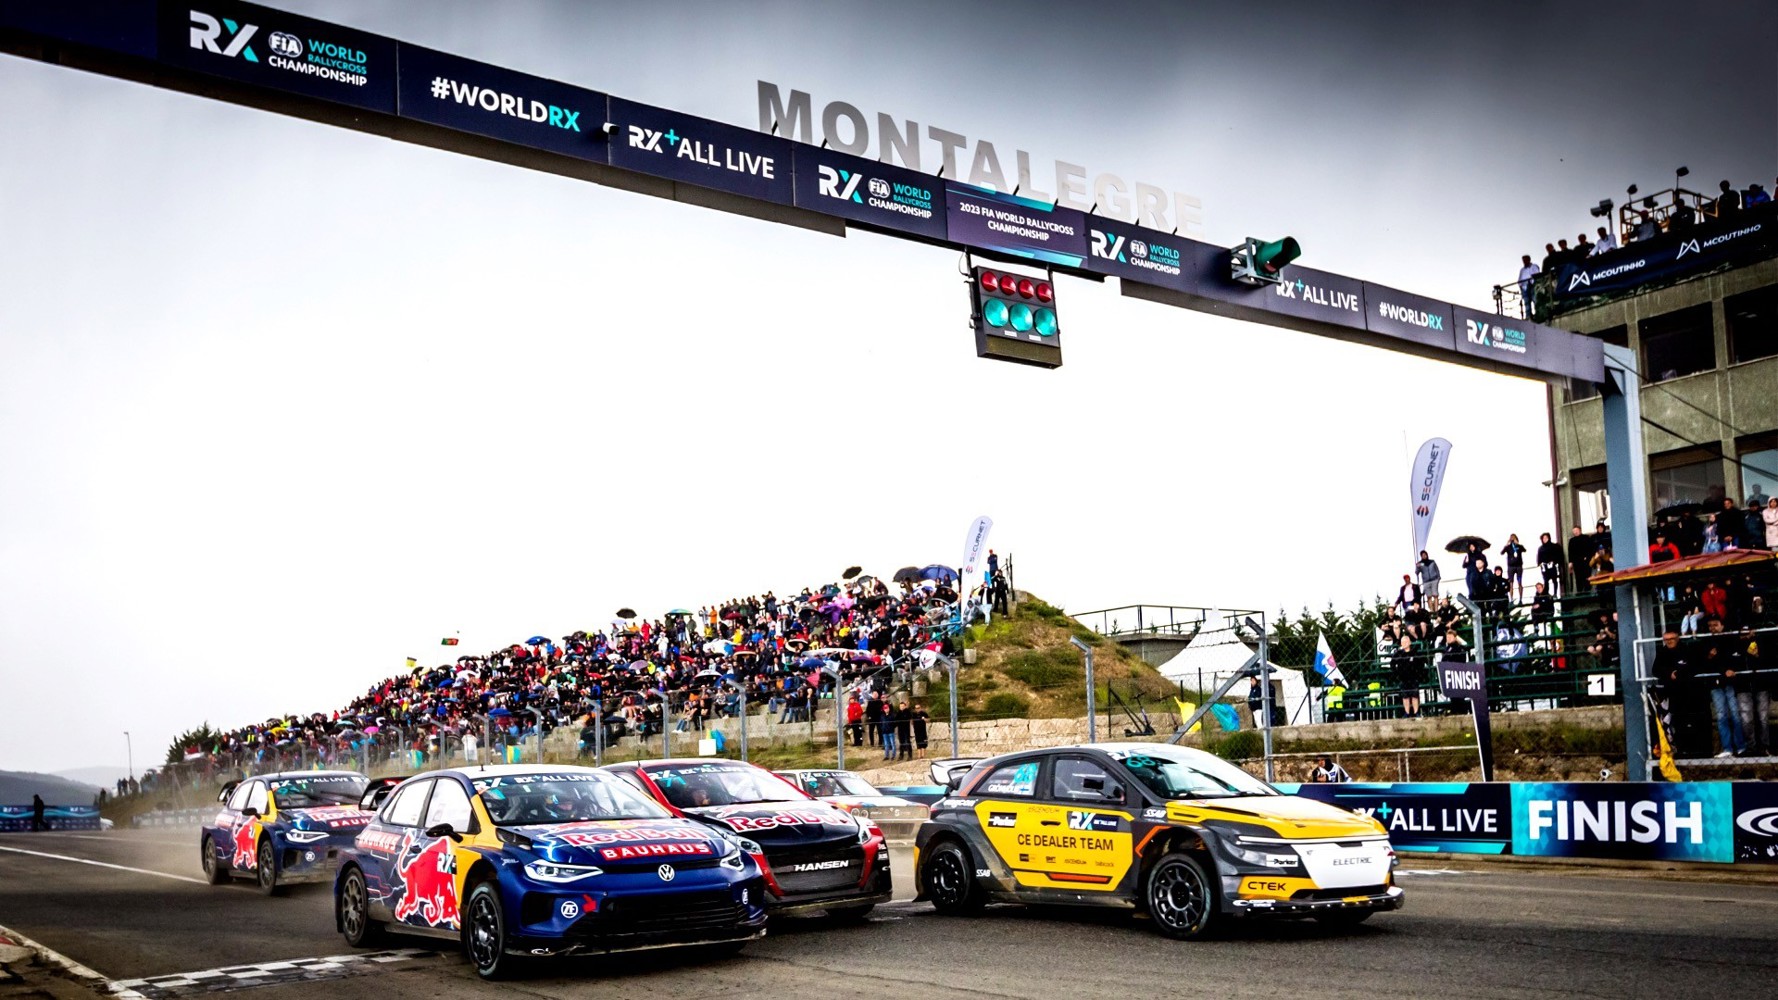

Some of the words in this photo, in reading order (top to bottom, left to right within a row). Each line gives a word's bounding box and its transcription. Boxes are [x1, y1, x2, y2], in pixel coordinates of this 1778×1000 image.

[189, 9, 259, 63] RX
[271, 35, 300, 54] FIA
[308, 38, 367, 64] WORLD
[268, 55, 367, 87] CHAMPIONSHIP
[307, 53, 367, 75] RALLYCROSS
[430, 76, 581, 132] #WORLDRX
[726, 148, 775, 180] LIVE
[757, 79, 1206, 239] MONTALEGRE
[818, 164, 863, 204] RX
[869, 180, 888, 195] FIA
[893, 182, 931, 201] WORLD
[868, 197, 932, 219] CHAMPIONSHIP
[893, 193, 932, 210] RALLYCROSS
[959, 202, 981, 215] 2023
[981, 207, 995, 218] FIA
[995, 209, 1025, 225] WORLD
[1026, 217, 1074, 236] RALLYCROSS
[987, 220, 1050, 241] CHAMPIONSHIP
[1704, 224, 1762, 248] MCOUTINHO
[1090, 229, 1127, 263] RX
[1149, 243, 1180, 259] WORLD
[1130, 257, 1181, 276] CHAMPIONSHIP
[1592, 259, 1646, 281] MCOUTINHO
[1329, 290, 1359, 312] LIVE
[1379, 301, 1443, 331] #WORLDRX
[1466, 318, 1490, 347] RX
[1504, 328, 1525, 340] WORLD
[1444, 669, 1481, 691] FINISH
[1596, 676, 1605, 693] 1
[725, 810, 799, 832] Red
[1068, 810, 1097, 830] RX
[1143, 808, 1167, 818] SSAB
[1441, 806, 1498, 834] LIVE
[1527, 799, 1703, 844] FINISH
[563, 829, 640, 847] Red
[636, 827, 710, 841] Bull
[1017, 833, 1032, 846] CE
[1033, 834, 1077, 849] DEALER
[1079, 837, 1114, 851] TEAM
[602, 843, 711, 859] BAUHAUS
[794, 859, 849, 872] HANSEN
[1272, 858, 1298, 866] Parker
[1332, 857, 1373, 867] ELECTRIC
[976, 869, 991, 878] SSAB
[1247, 881, 1287, 891] CTEK
[561, 900, 579, 918] ZF
